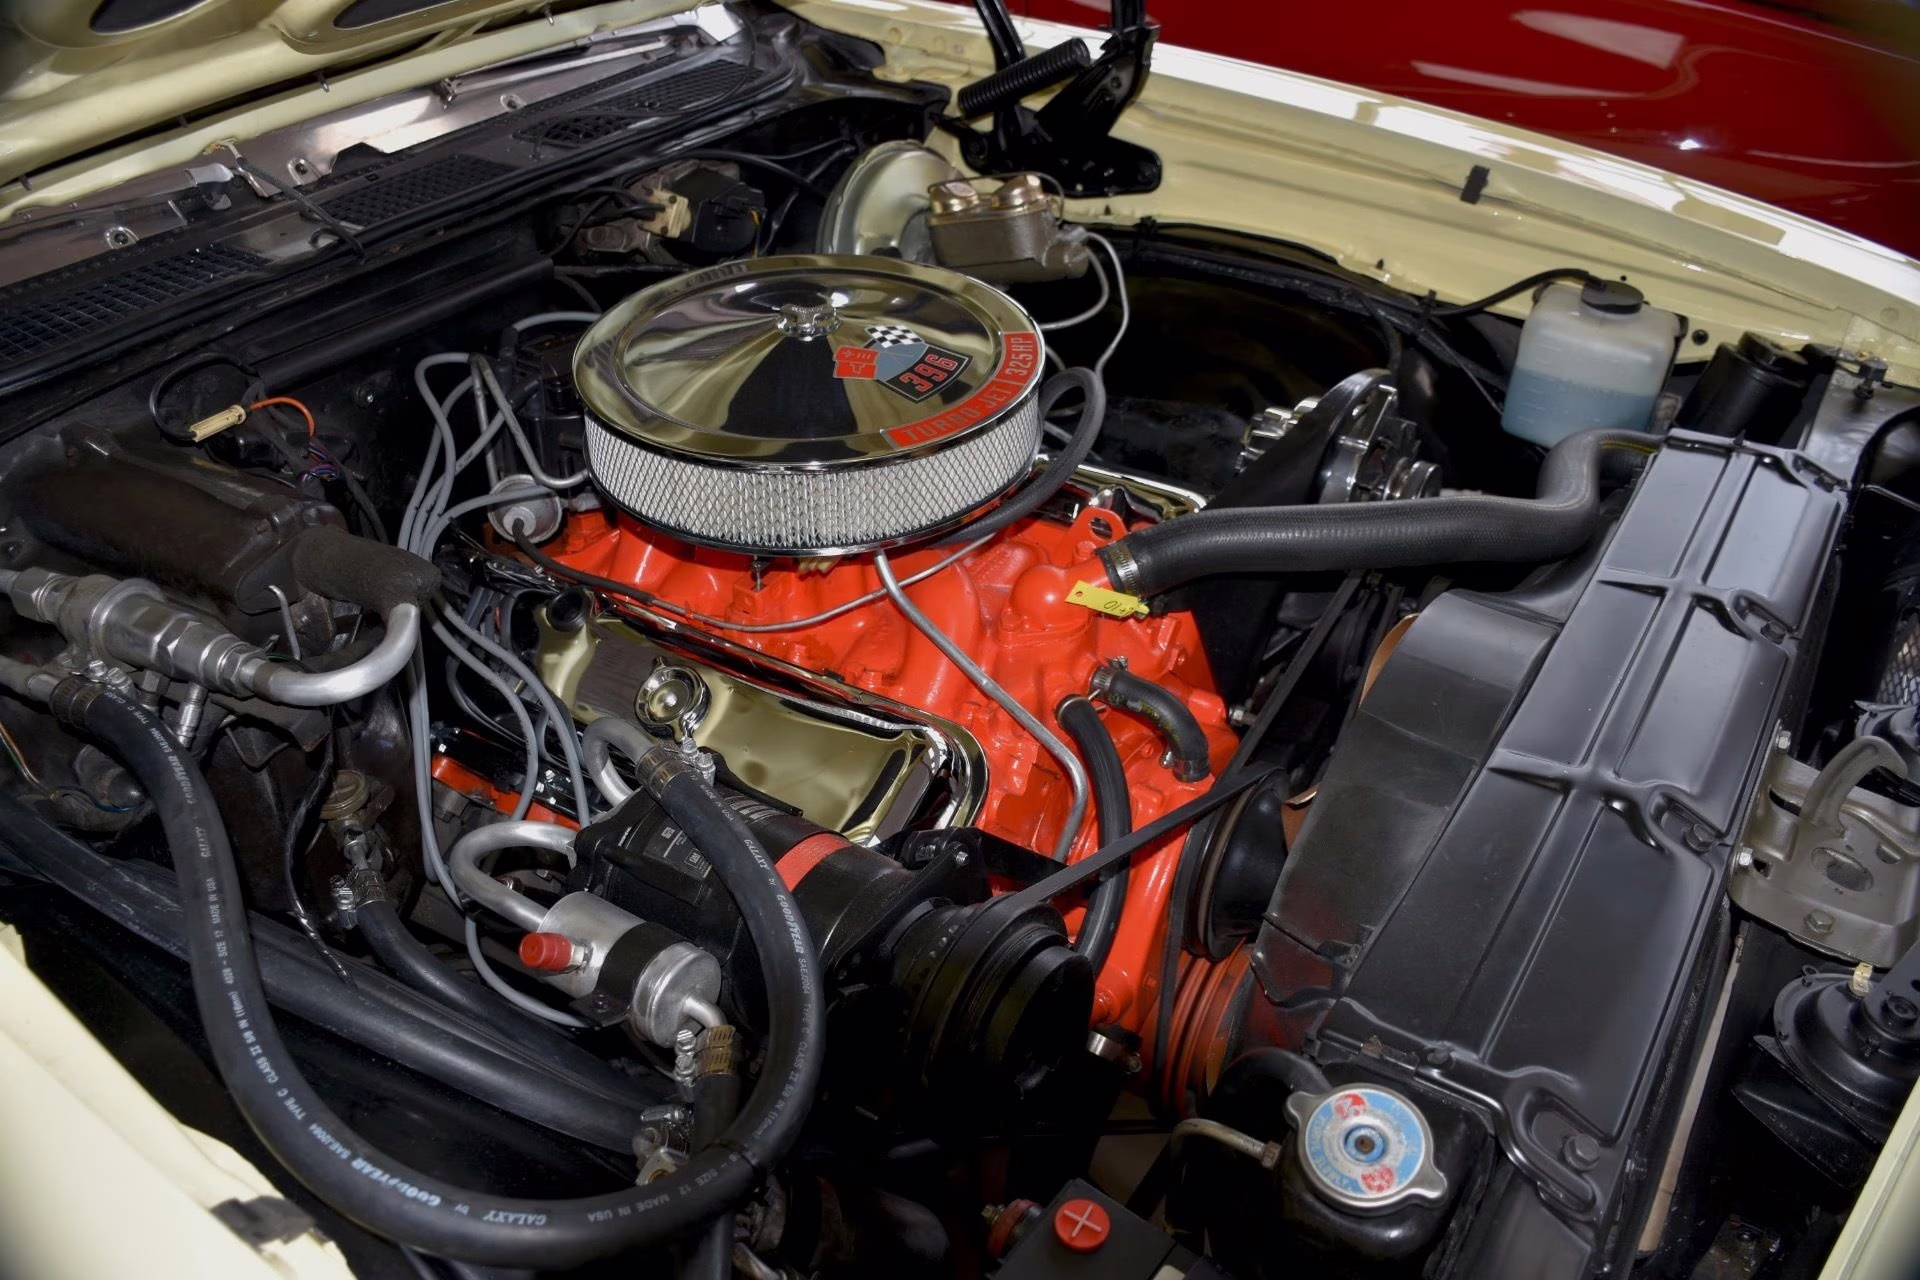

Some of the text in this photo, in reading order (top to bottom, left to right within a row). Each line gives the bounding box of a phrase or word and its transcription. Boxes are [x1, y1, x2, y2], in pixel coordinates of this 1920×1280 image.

[1005, 337, 1034, 377] 325HP
[900, 353, 957, 393] 396
[902, 387, 1014, 441] TURBO-JET
[743, 839, 770, 871] GALAXY
[776, 894, 805, 954] GOODYEAR
[209, 904, 221, 924] MADE
[216, 941, 228, 957] SIZE
[238, 1019, 249, 1029] IN
[249, 1045, 262, 1056] II
[256, 1057, 279, 1084] CLASS
[277, 1088, 289, 1097] C
[284, 1097, 307, 1120] TYPE
[351, 1157, 442, 1207] GOODYEAR
[617, 1205, 632, 1217] IN
[637, 1194, 670, 1213] MADE
[482, 1210, 547, 1226] GALAXY
[586, 1210, 613, 1224] USA
